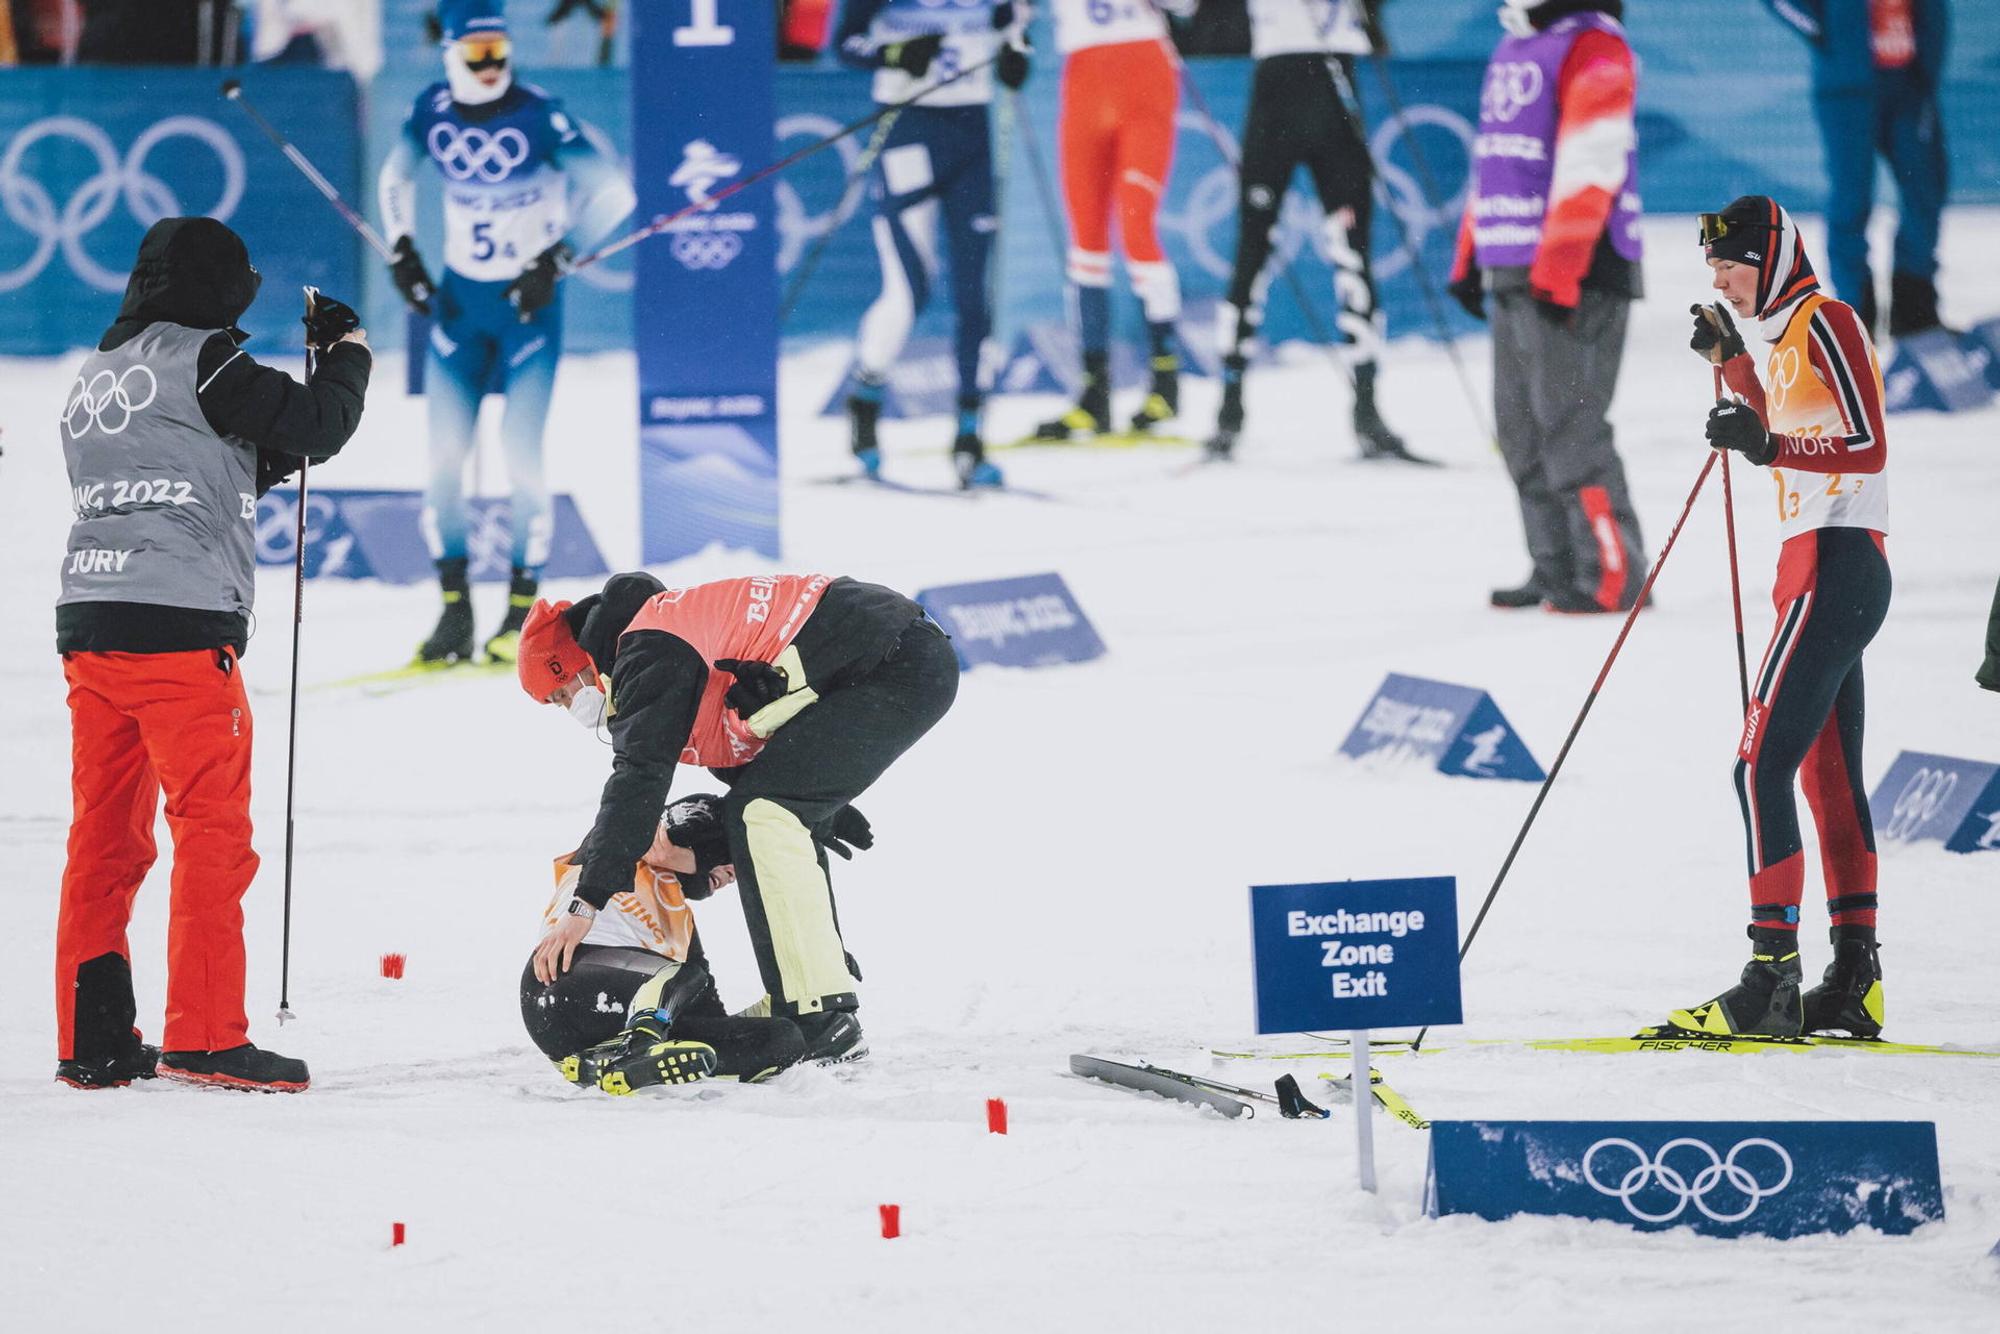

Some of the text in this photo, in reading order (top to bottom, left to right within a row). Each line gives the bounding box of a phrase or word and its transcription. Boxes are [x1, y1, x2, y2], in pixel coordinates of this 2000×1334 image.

[472, 222, 495, 261] 5
[1785, 436, 1837, 456] NOR
[111, 479, 201, 507] 2022
[68, 549, 133, 575] JURY
[1287, 908, 1425, 938] Exchange
[1320, 940, 1394, 967] Zone
[1332, 970, 1388, 998] Exit
[1639, 1040, 1733, 1052] FISCHER
